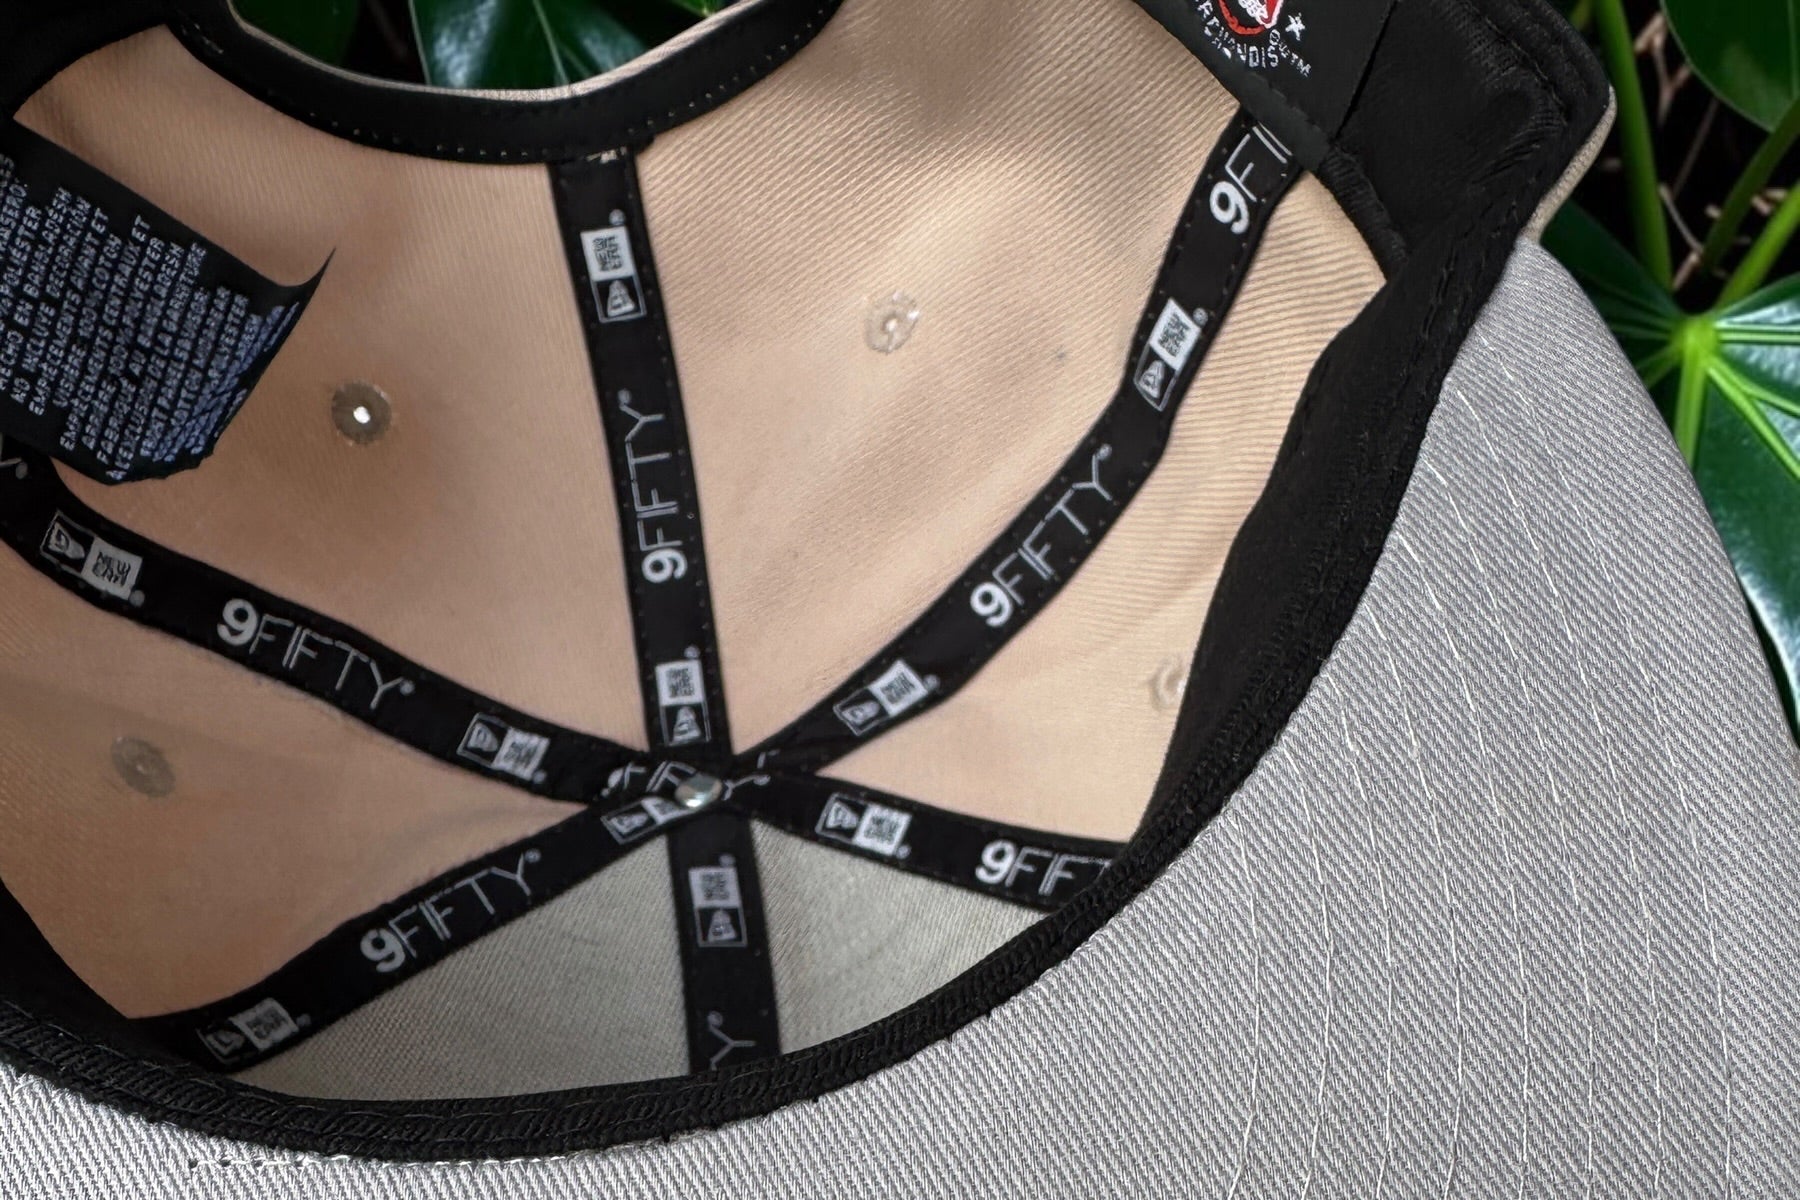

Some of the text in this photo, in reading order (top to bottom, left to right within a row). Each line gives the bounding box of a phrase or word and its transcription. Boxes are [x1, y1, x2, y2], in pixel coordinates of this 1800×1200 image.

[970, 454, 1112, 628] 9FIFTY
[217, 598, 403, 710] 9FIFTY
[360, 853, 532, 973] 9FIFTY
